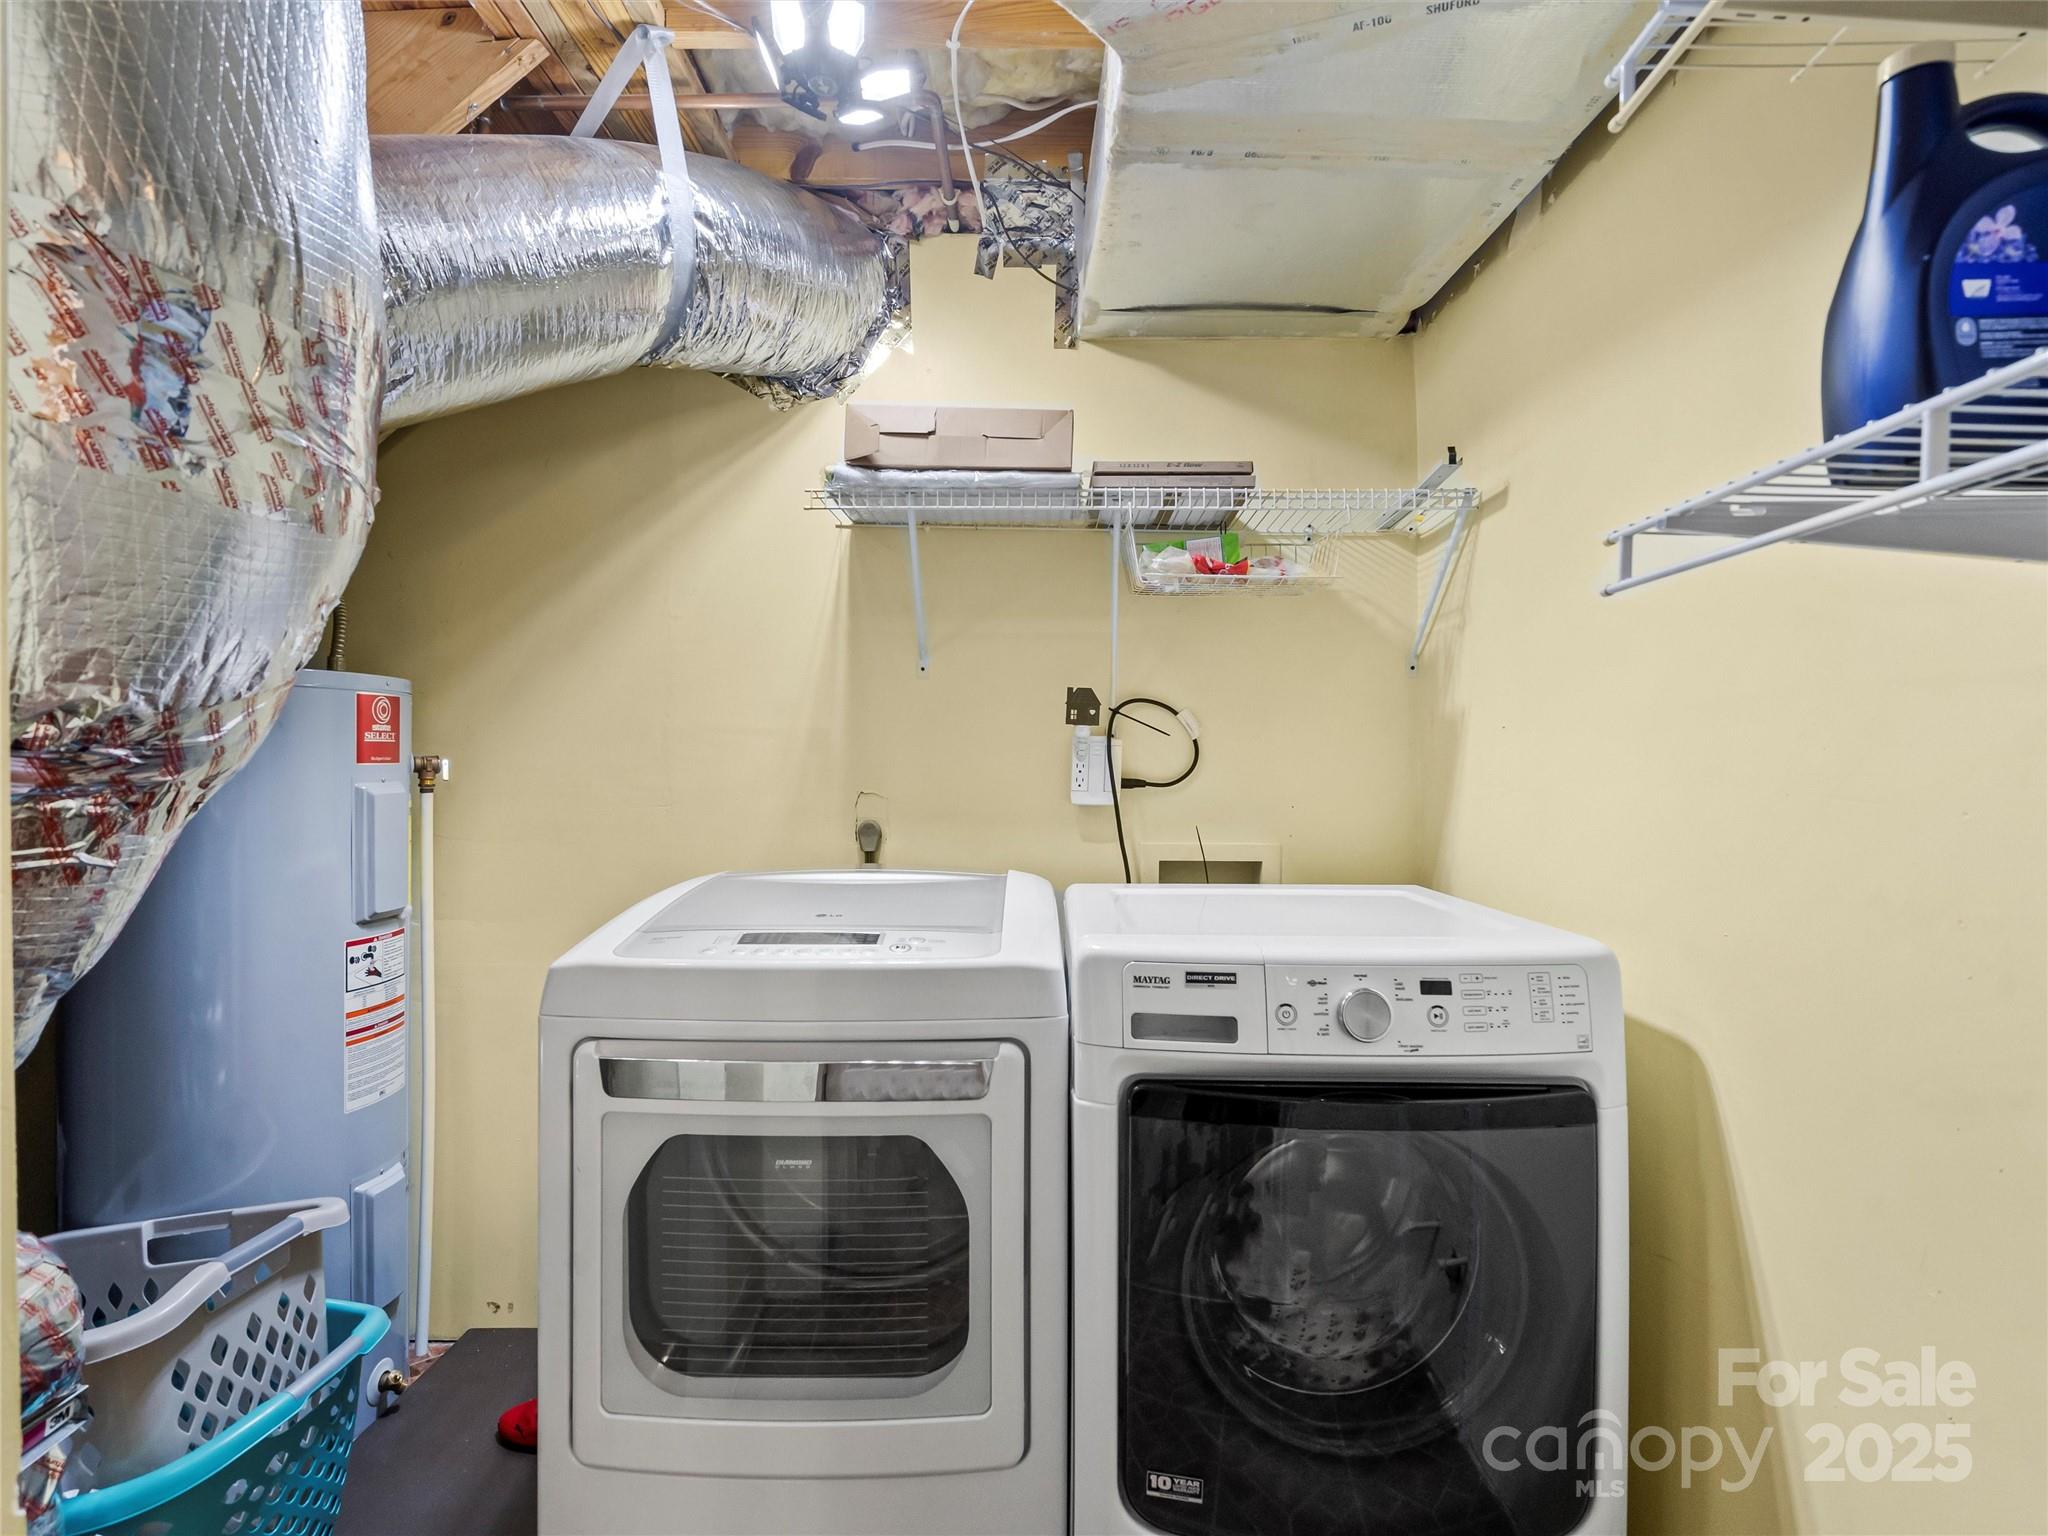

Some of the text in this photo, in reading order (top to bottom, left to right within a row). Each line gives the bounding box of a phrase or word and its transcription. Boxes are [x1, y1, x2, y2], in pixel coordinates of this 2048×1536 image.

[202, 393, 235, 456] Venture Tape
[364, 732, 396, 741] SELECT
[1133, 975, 1170, 985] MAYTAG
[1150, 1474, 1172, 1491] 10
[1173, 1477, 1200, 1488] YEAR
